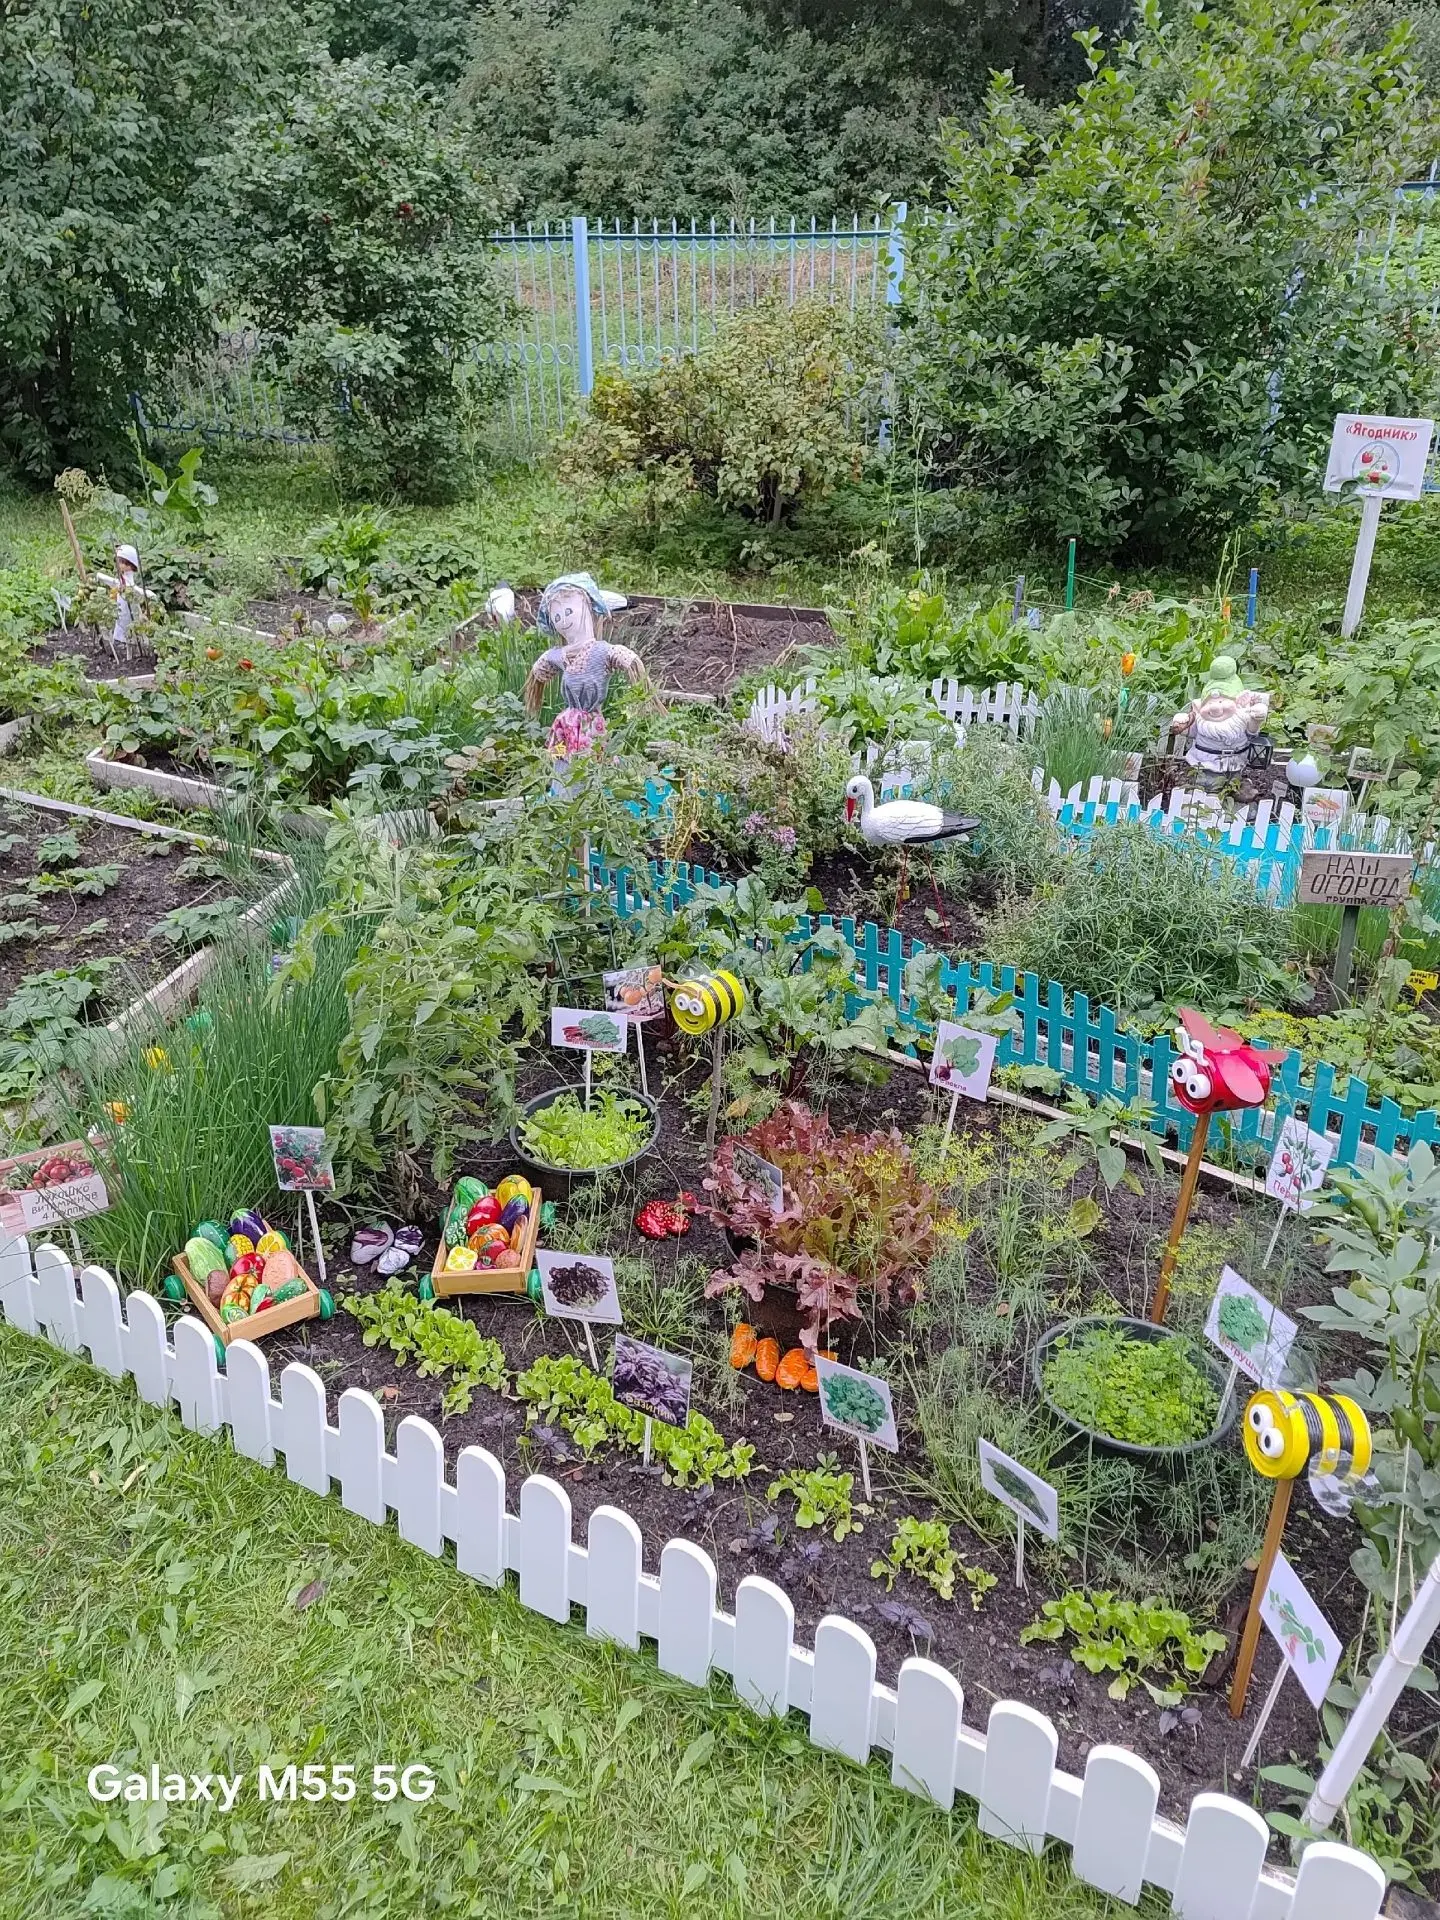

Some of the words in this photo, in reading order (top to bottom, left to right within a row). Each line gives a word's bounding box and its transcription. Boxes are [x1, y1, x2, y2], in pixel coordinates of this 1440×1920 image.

[1346, 422, 1418, 441] «Ягодник»
[1326, 856, 1380, 875] НАШ
[1310, 874, 1400, 898] ОГОРОД
